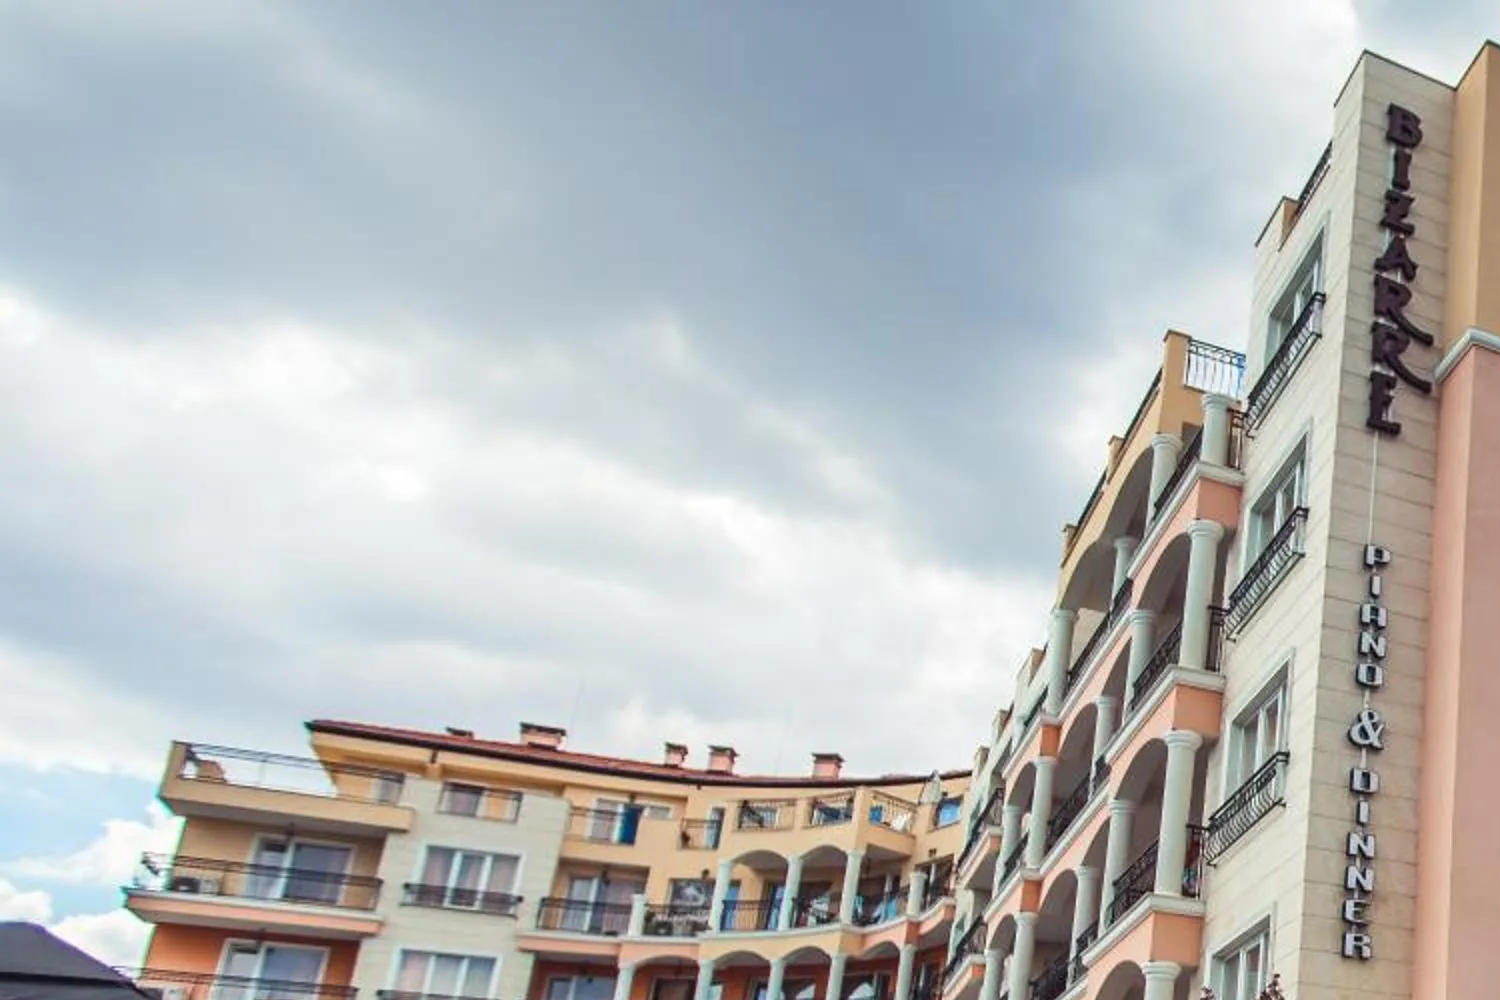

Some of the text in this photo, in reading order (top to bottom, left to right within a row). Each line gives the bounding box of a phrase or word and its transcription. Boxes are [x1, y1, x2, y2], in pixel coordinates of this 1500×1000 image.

[1366, 102, 1435, 436] BIZARRE
[1342, 543, 1391, 960] PIANO & DINNER
